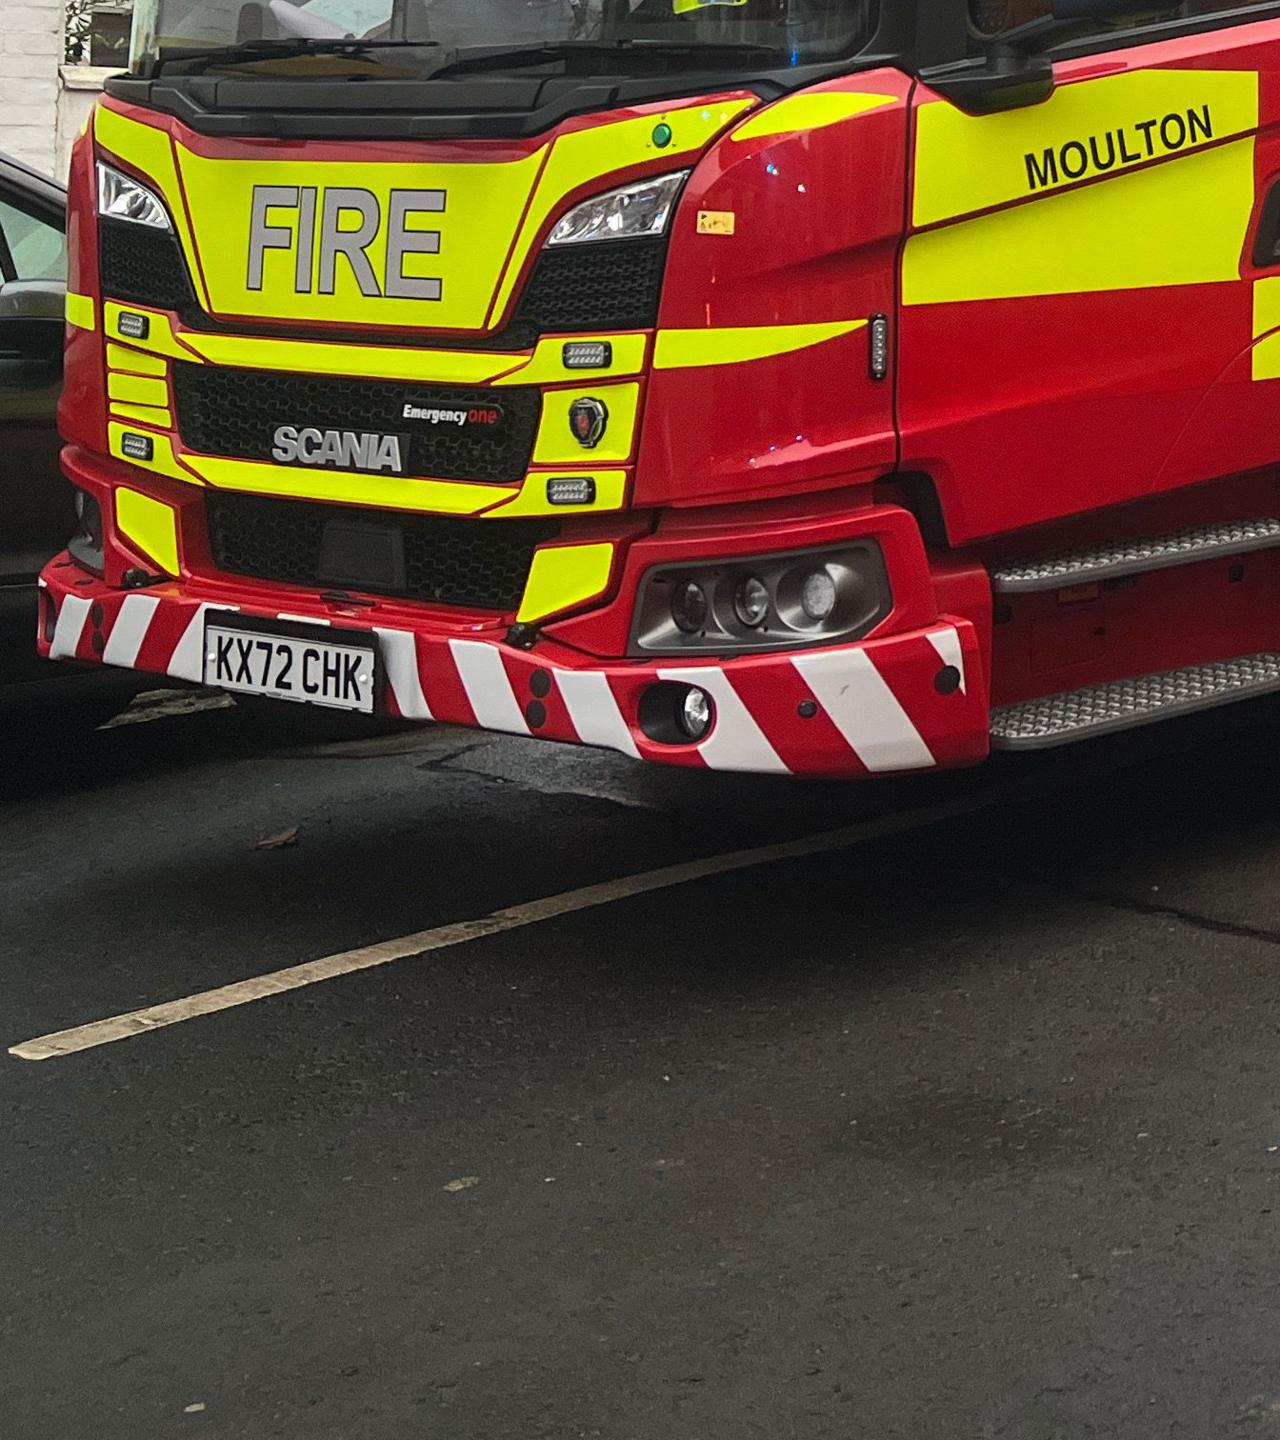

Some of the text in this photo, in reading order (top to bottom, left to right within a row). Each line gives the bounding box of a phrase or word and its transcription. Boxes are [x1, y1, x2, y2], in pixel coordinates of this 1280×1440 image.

[1024, 104, 1213, 190] MOULTON
[246, 184, 447, 301] FIRE
[272, 425, 402, 472] SCANIA
[217, 635, 362, 701] KX72 CHK
